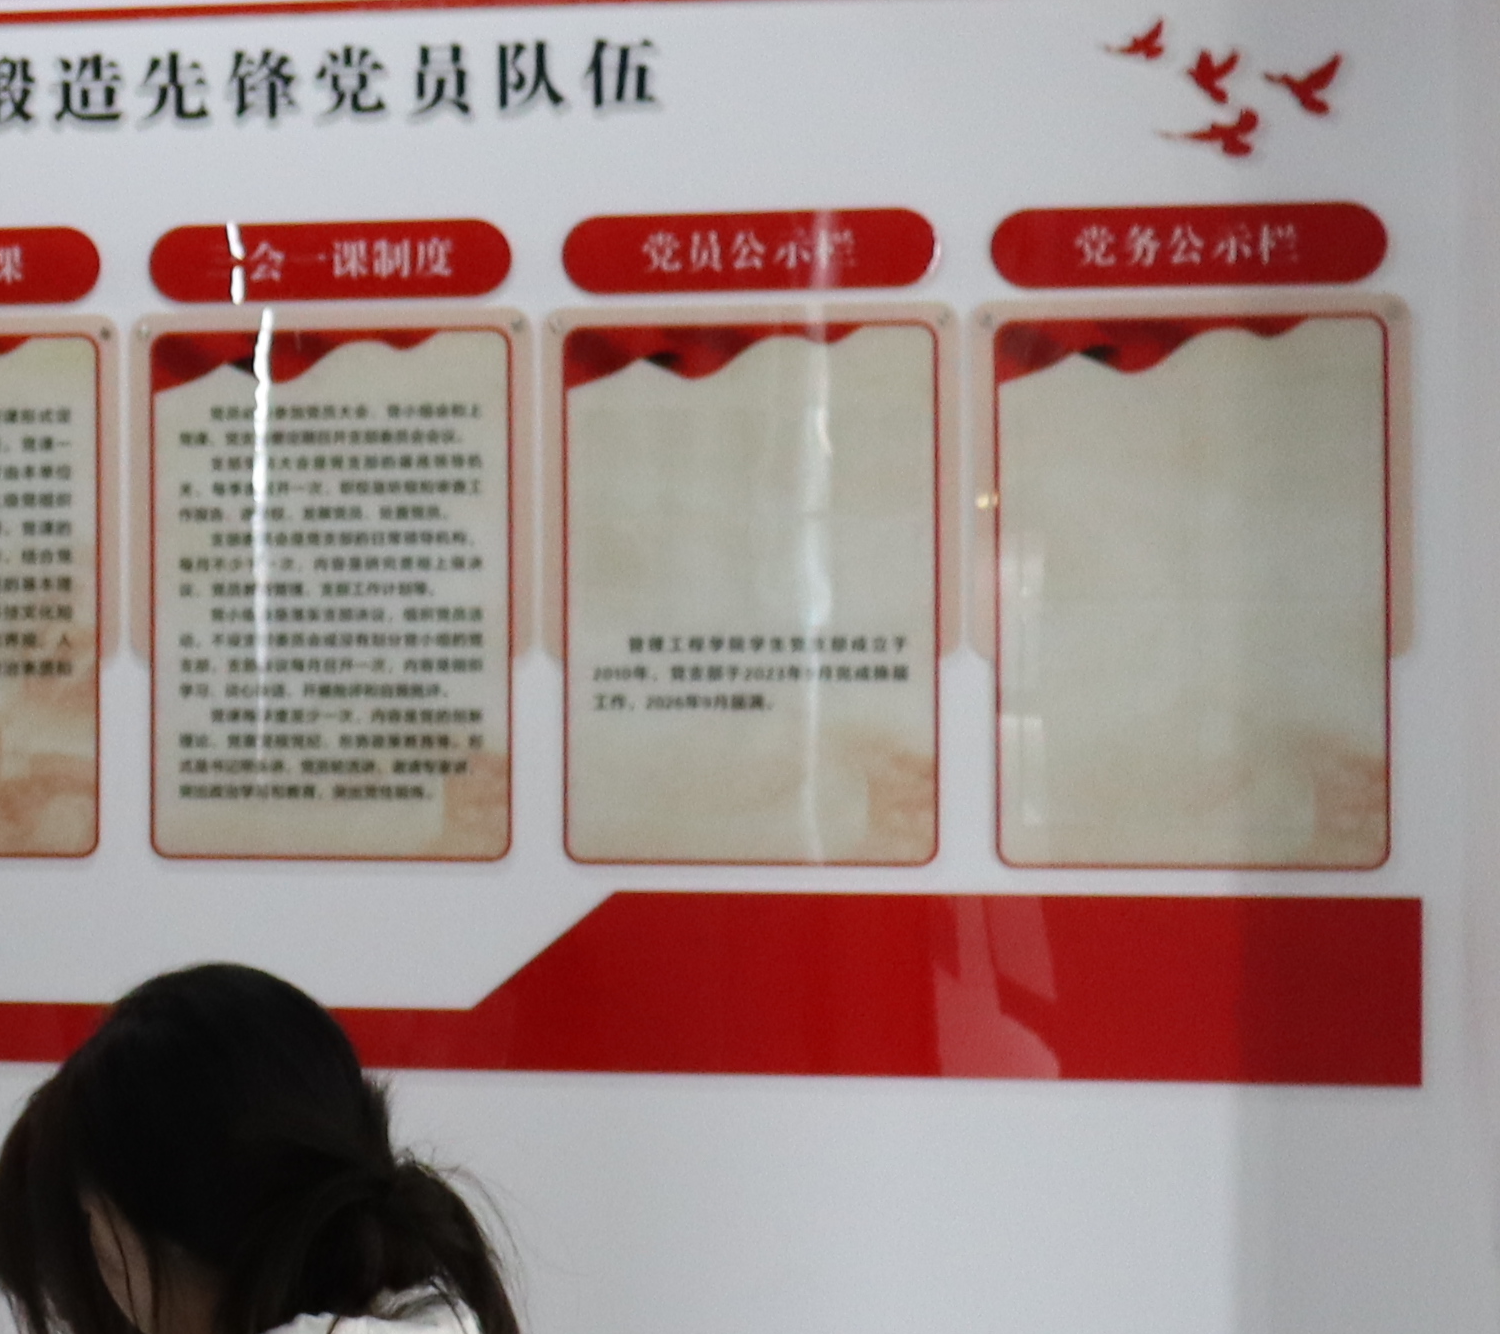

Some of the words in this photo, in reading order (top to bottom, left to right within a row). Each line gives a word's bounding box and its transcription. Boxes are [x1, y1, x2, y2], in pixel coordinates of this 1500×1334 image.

[641, 229, 856, 274] 党员公示栏
[1074, 221, 1301, 267] 党务公示栏
